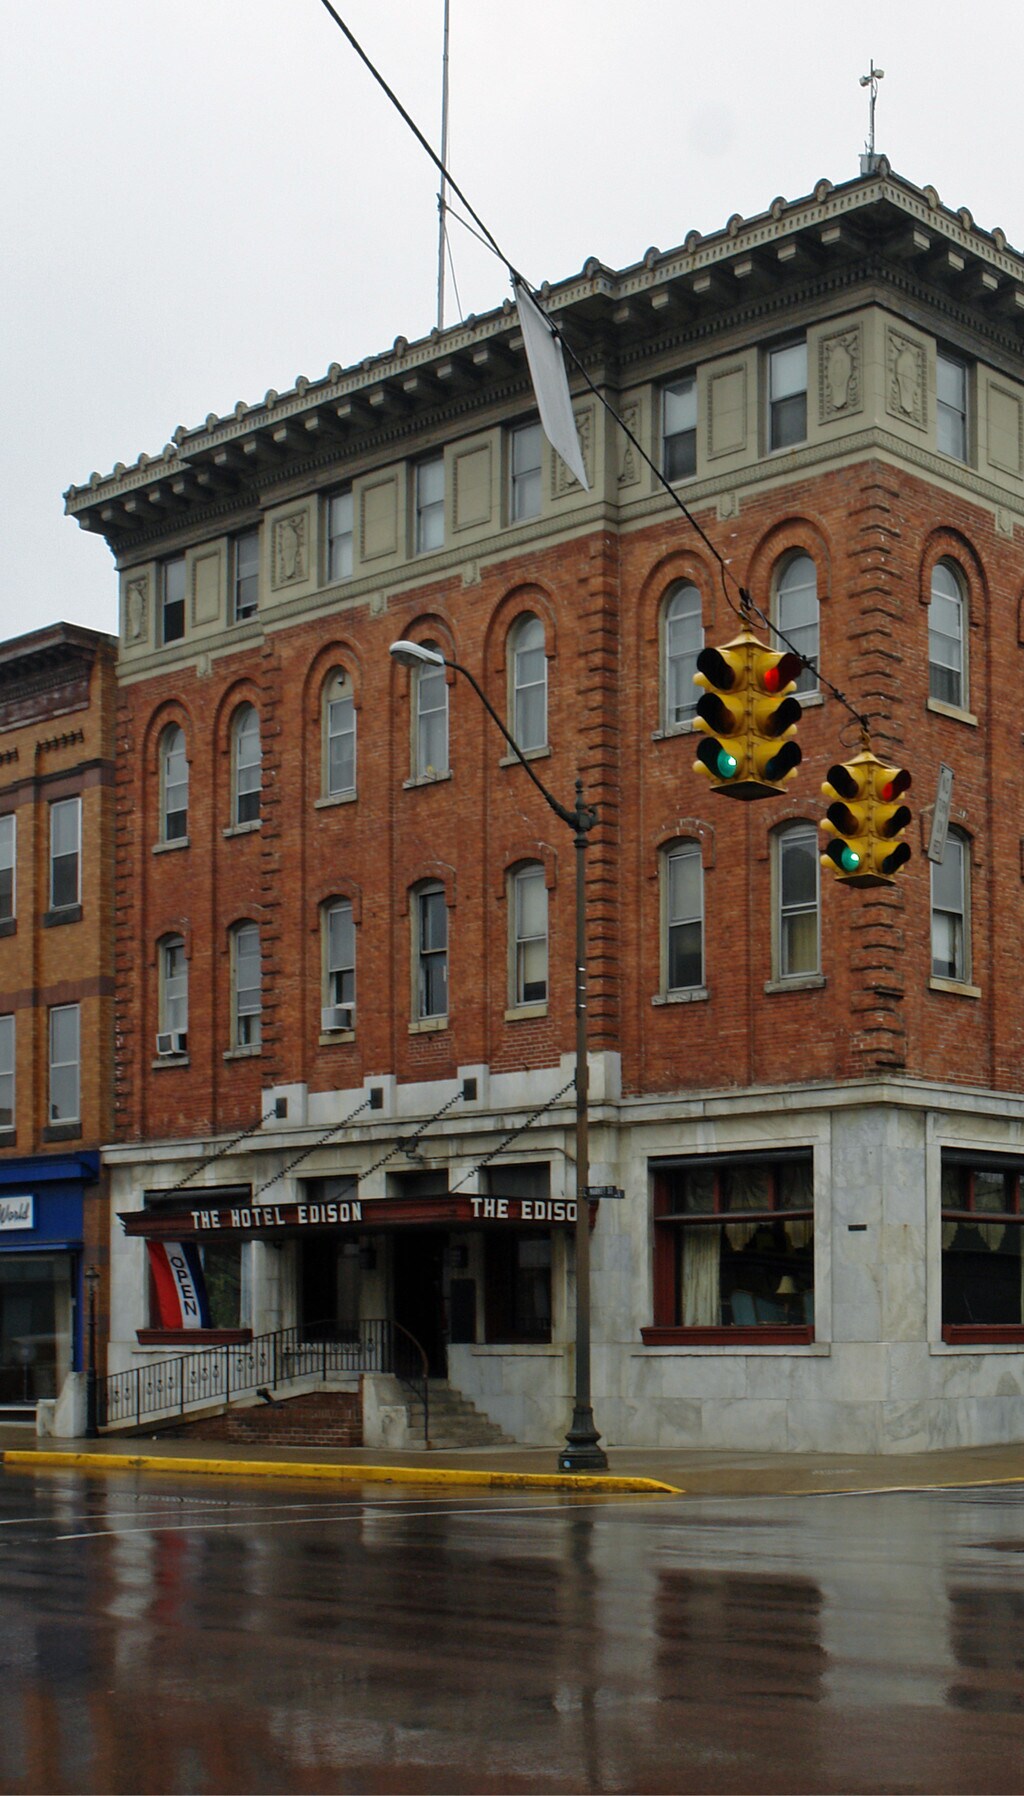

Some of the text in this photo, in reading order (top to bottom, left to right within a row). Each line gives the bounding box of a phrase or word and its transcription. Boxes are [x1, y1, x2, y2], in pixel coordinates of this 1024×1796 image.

[191, 1202, 362, 1230] THE HOTEL EDISON
[470, 1198, 577, 1222] THE EDISO
[170, 1256, 197, 1316] OPEN
